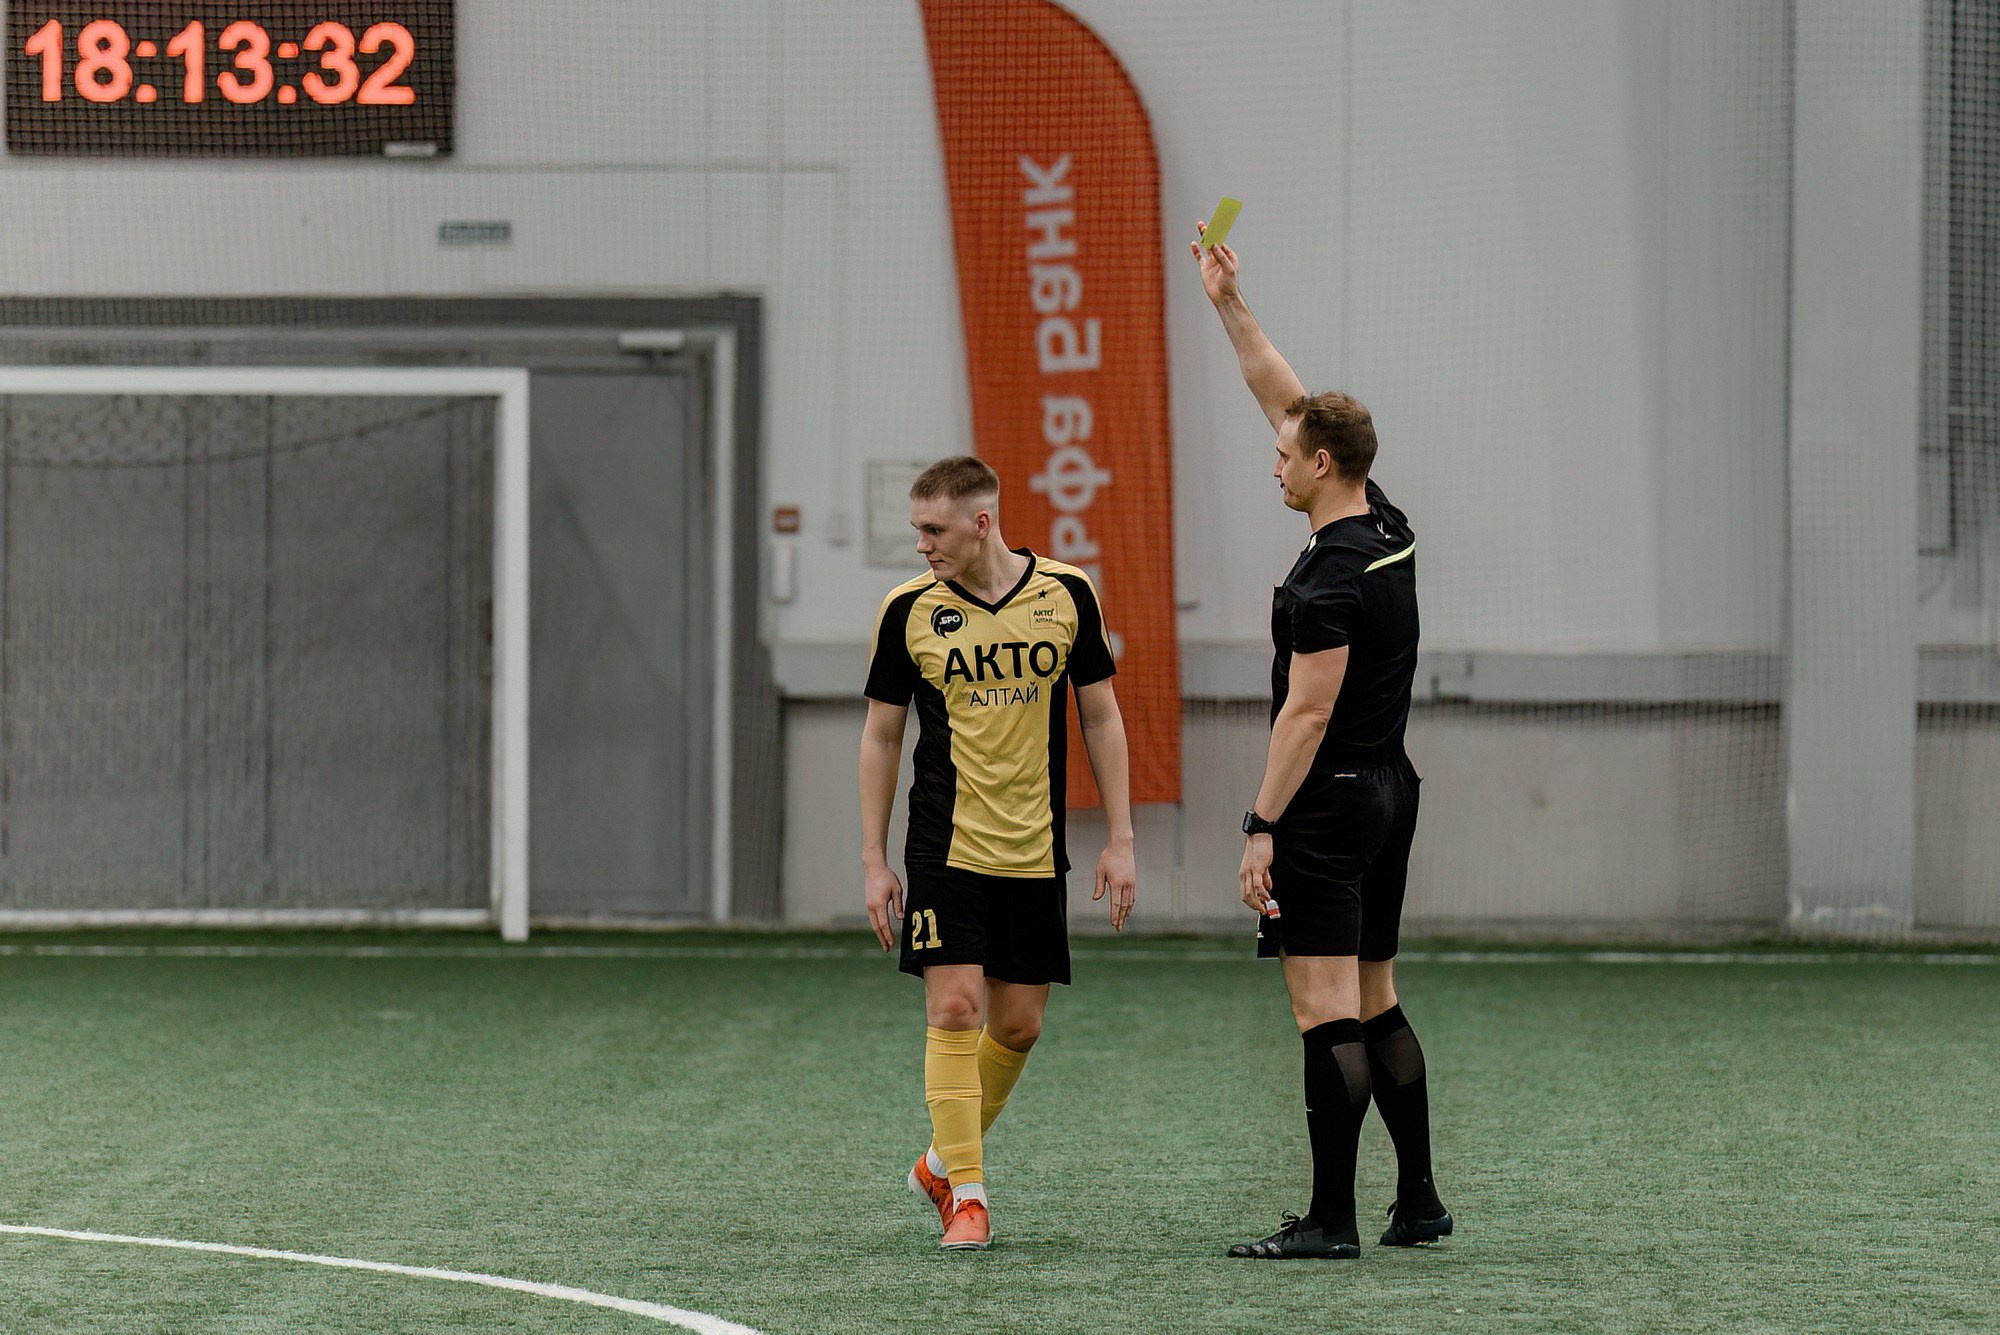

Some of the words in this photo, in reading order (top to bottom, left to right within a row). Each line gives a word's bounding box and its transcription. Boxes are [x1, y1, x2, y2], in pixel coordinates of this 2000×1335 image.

[25, 19, 416, 104] 18:13:32
[944, 641, 1059, 684] АКТО
[970, 682, 1039, 707] АЛТАЙ
[912, 909, 942, 950] 21
